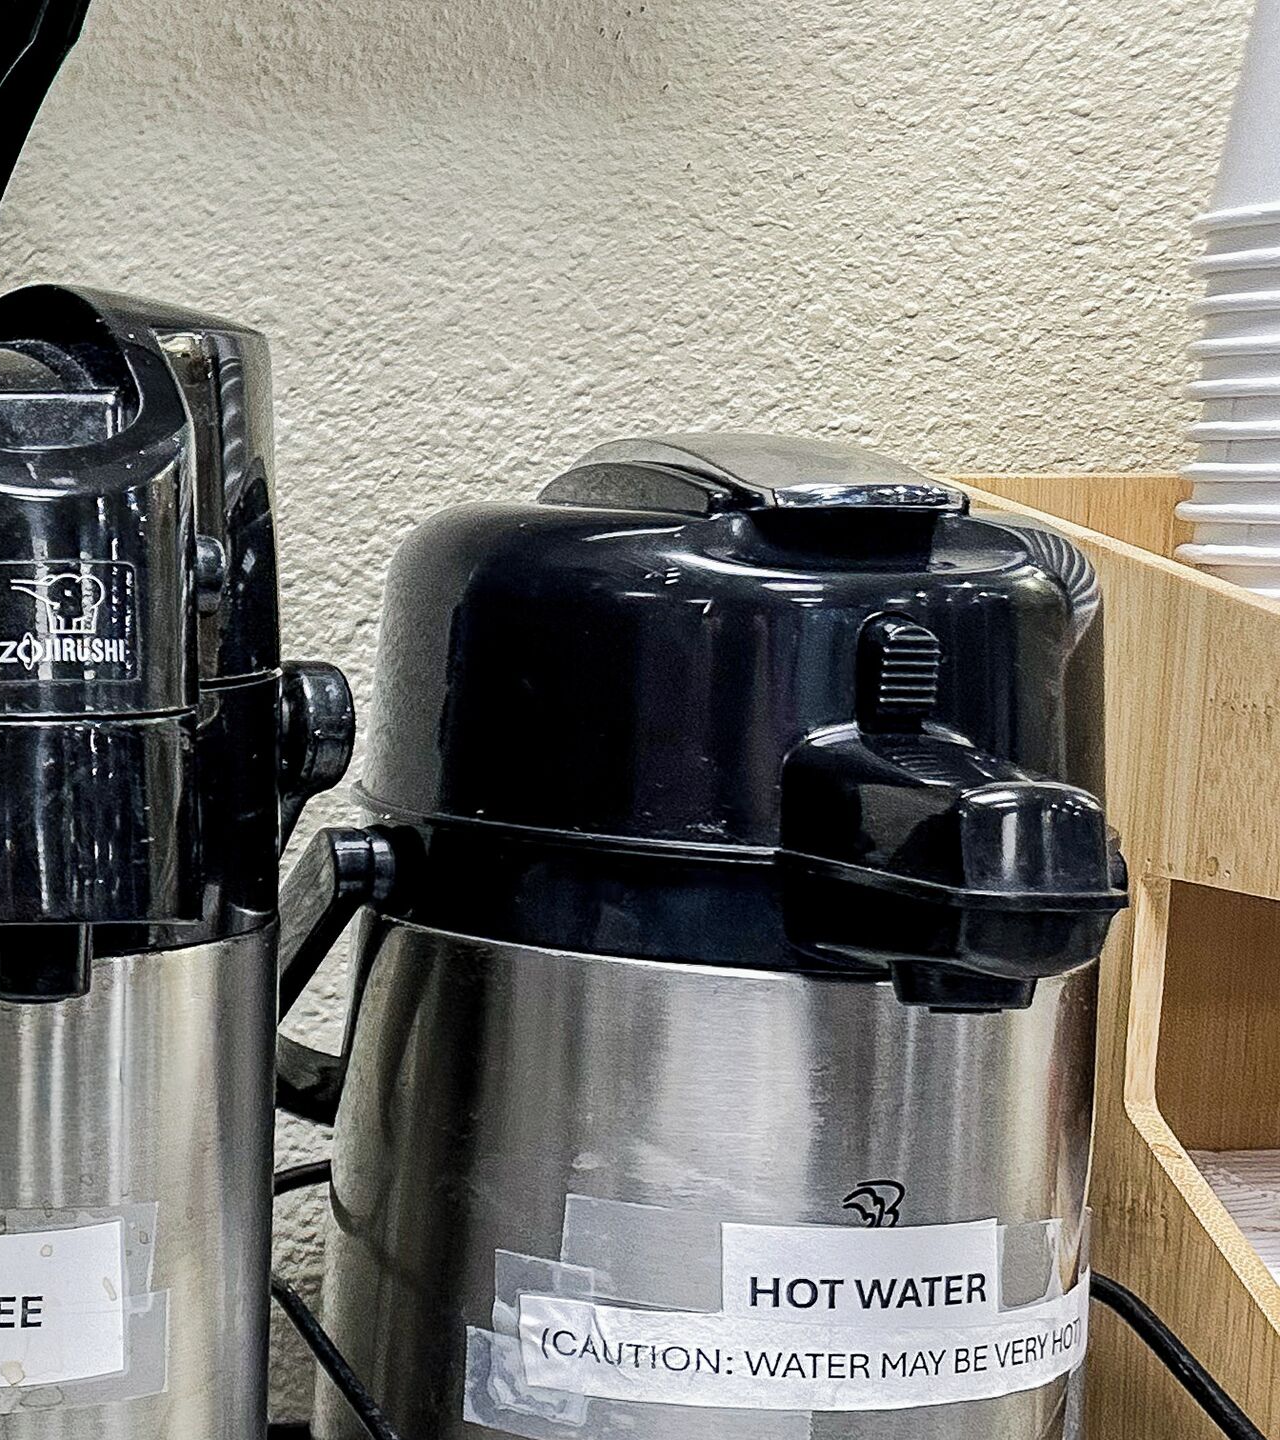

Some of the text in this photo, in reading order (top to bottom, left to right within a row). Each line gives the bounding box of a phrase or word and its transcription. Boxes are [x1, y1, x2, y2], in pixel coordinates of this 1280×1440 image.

[749, 1273, 988, 1310] HOT WATER
[541, 1327, 734, 1376] (CAUTION:
[744, 1350, 871, 1380] WATER
[880, 1349, 947, 1379] MAY
[954, 1344, 989, 1375] BE
[994, 1333, 1049, 1369] VERY
